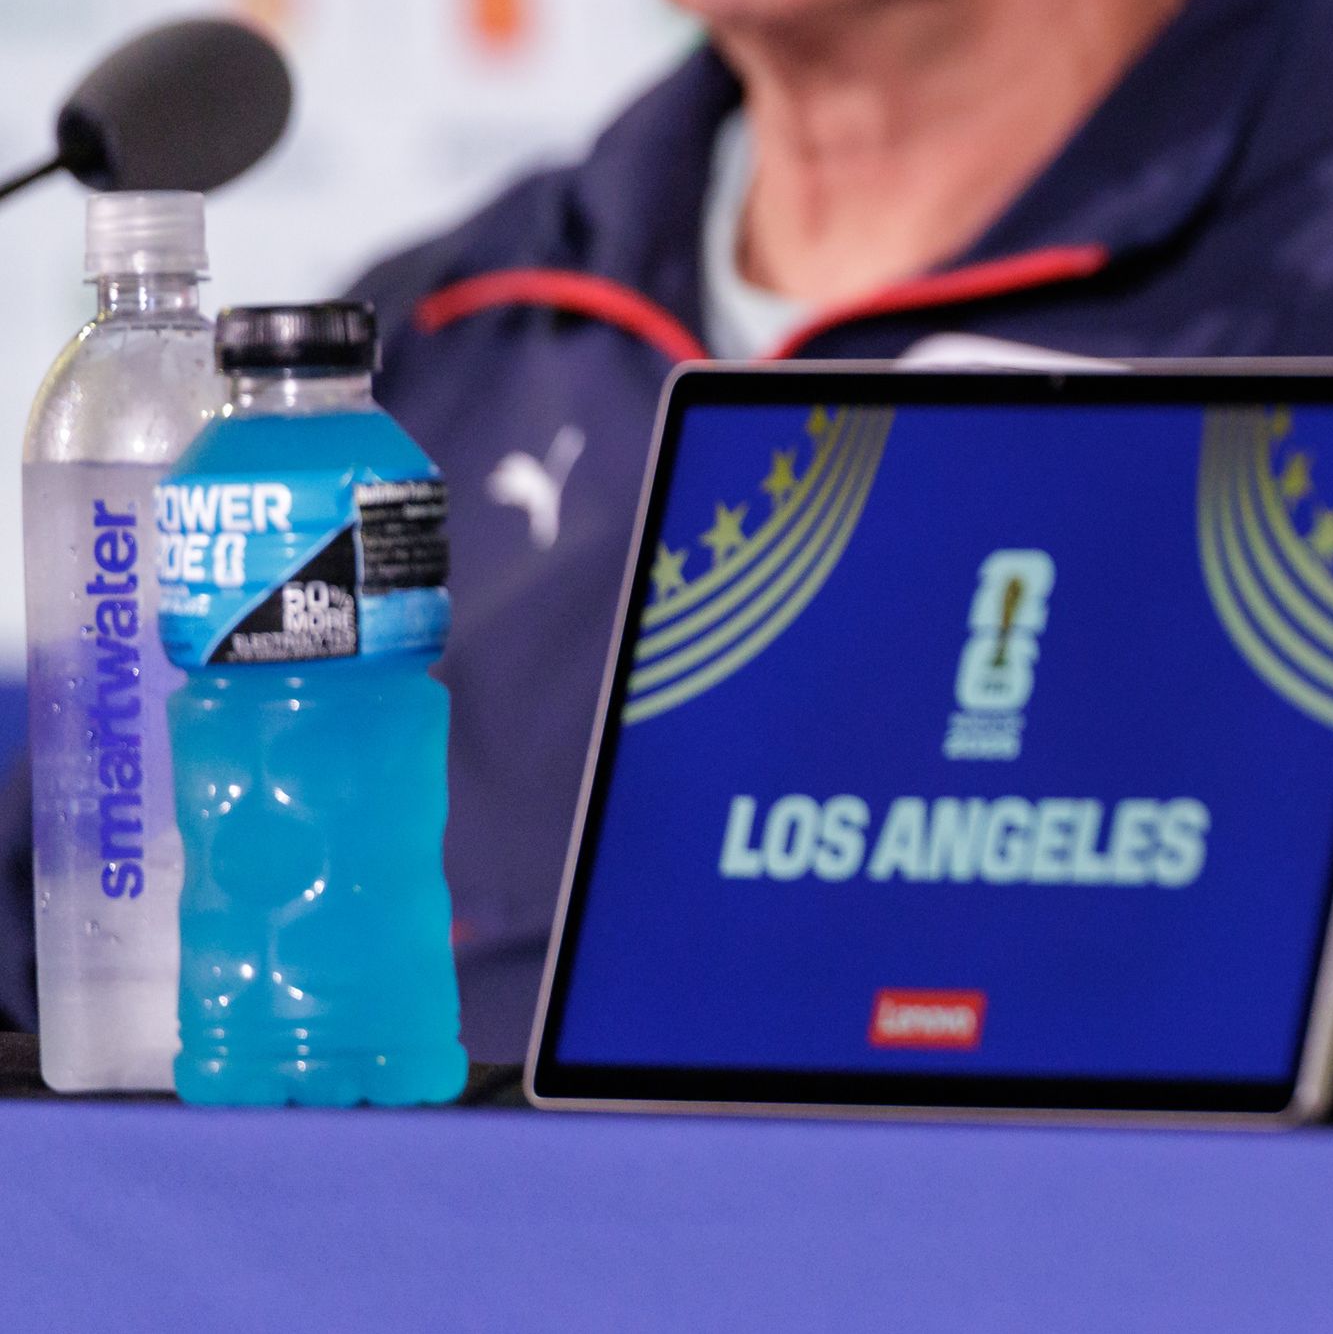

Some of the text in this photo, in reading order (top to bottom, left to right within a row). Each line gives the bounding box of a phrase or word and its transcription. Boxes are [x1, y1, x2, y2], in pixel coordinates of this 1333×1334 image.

[86, 499, 144, 899] smartwater
[721, 794, 1211, 888] LOS ANGELES
